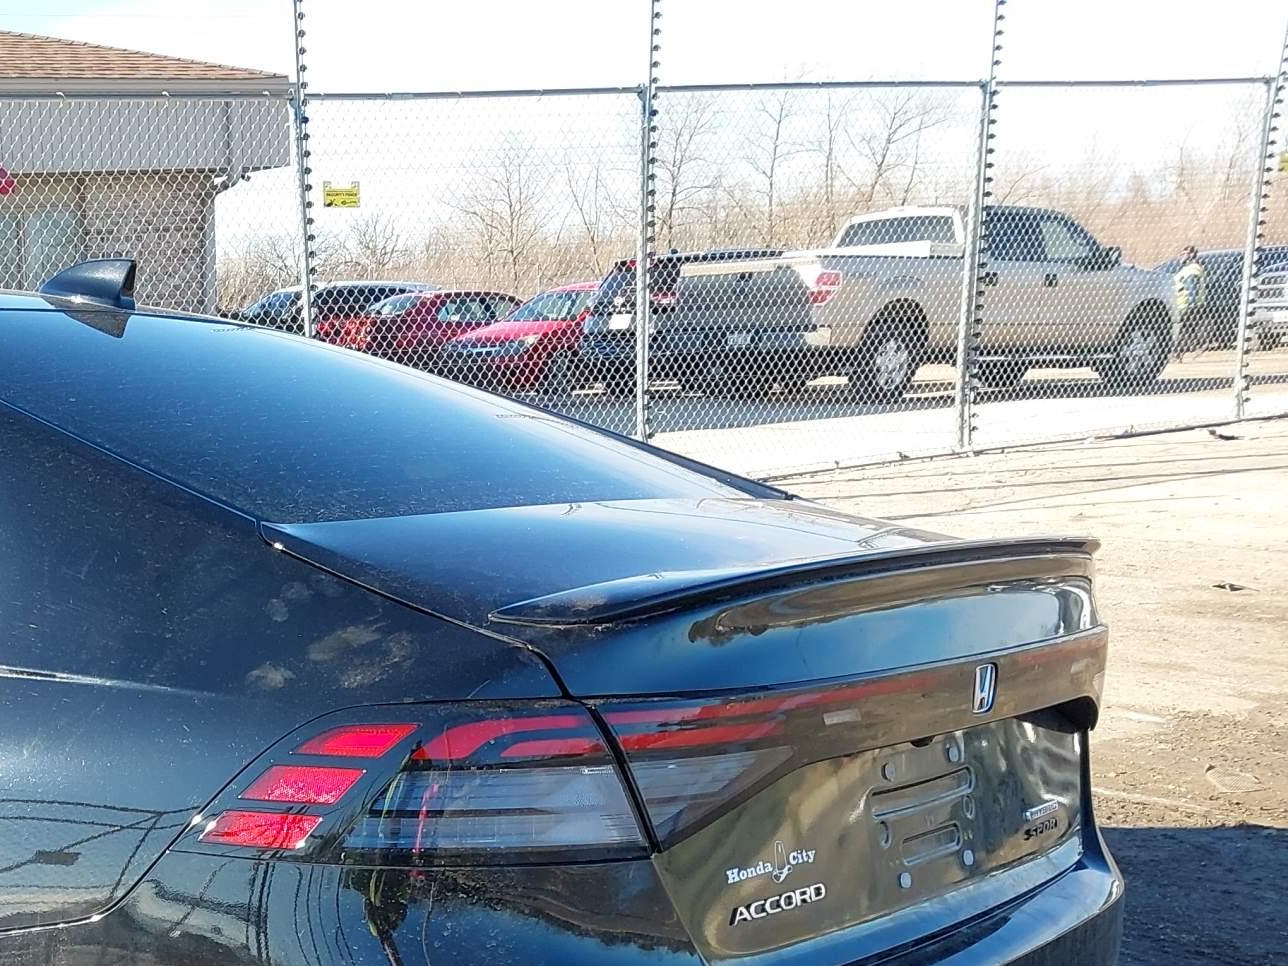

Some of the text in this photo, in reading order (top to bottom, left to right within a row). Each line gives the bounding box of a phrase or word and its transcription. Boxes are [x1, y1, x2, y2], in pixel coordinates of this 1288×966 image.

[726, 849, 816, 884] Honda City
[729, 883, 826, 926] ACCORD
